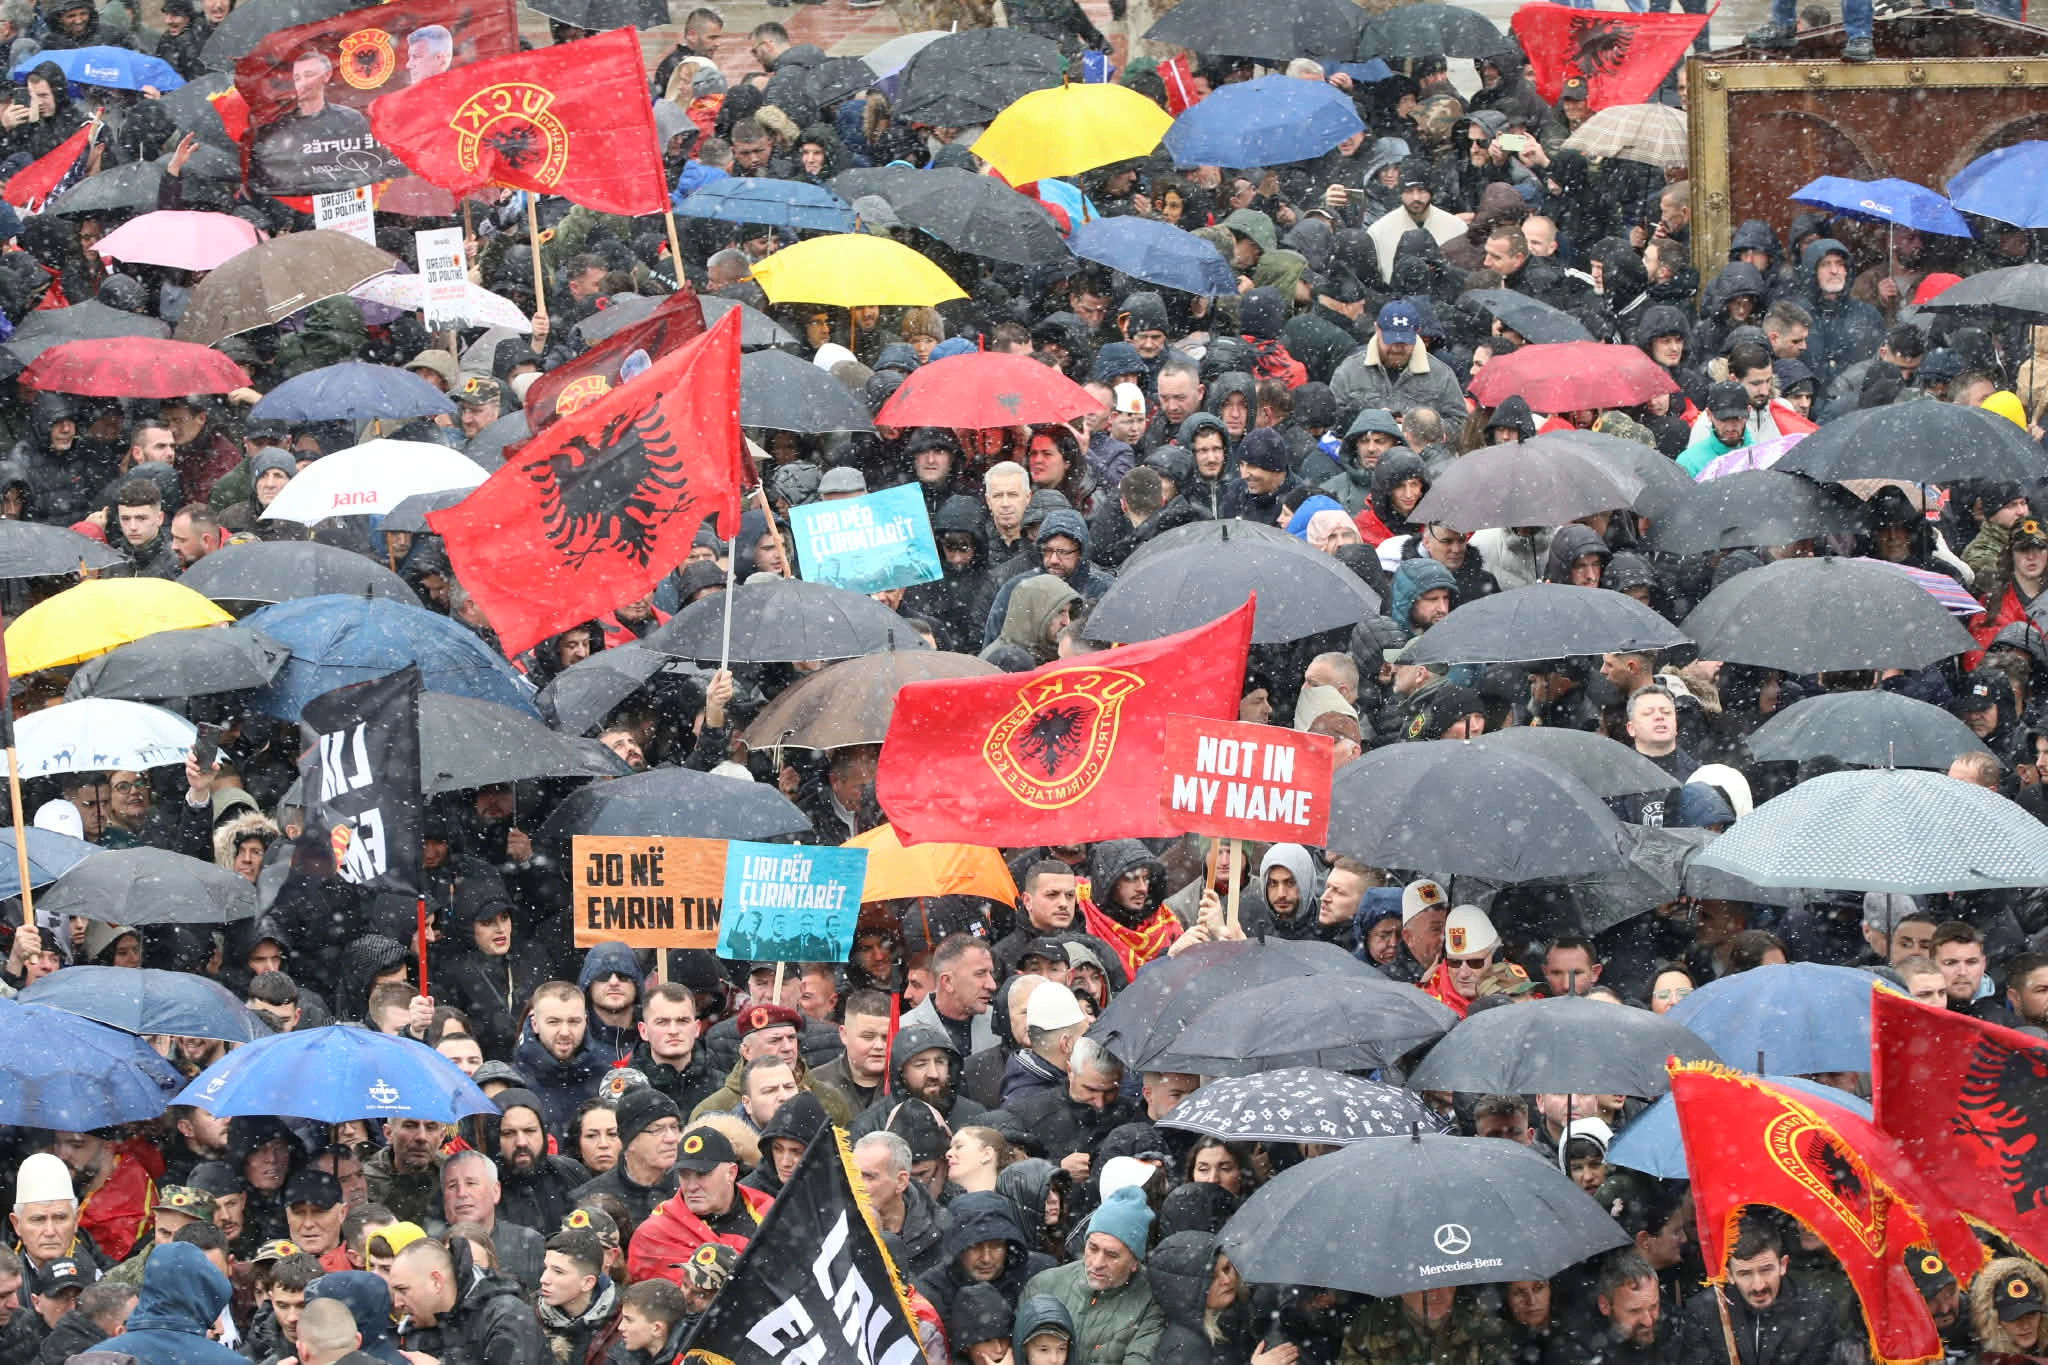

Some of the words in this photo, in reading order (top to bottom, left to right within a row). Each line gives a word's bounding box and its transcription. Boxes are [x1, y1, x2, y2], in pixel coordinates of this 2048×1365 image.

[322, 208, 333, 221] JO
[330, 490, 377, 510] jana
[806, 511, 841, 537] LIRI
[840, 503, 874, 530] PËR
[811, 515, 916, 563] ÇLIRIMTARËT
[1196, 735, 1258, 779] NOT
[1263, 743, 1295, 784] IN
[1172, 773, 1221, 816] MY
[1225, 781, 1313, 826] NAME
[586, 853, 624, 887] JO
[630, 846, 665, 887] NË
[743, 855, 780, 882] LIRI
[779, 853, 812, 883] PËR
[587, 896, 674, 930] EMRIN
[739, 880, 848, 913] ÇLIRIMTARËT
[1419, 1258, 1503, 1277] Mercedes-Benz
